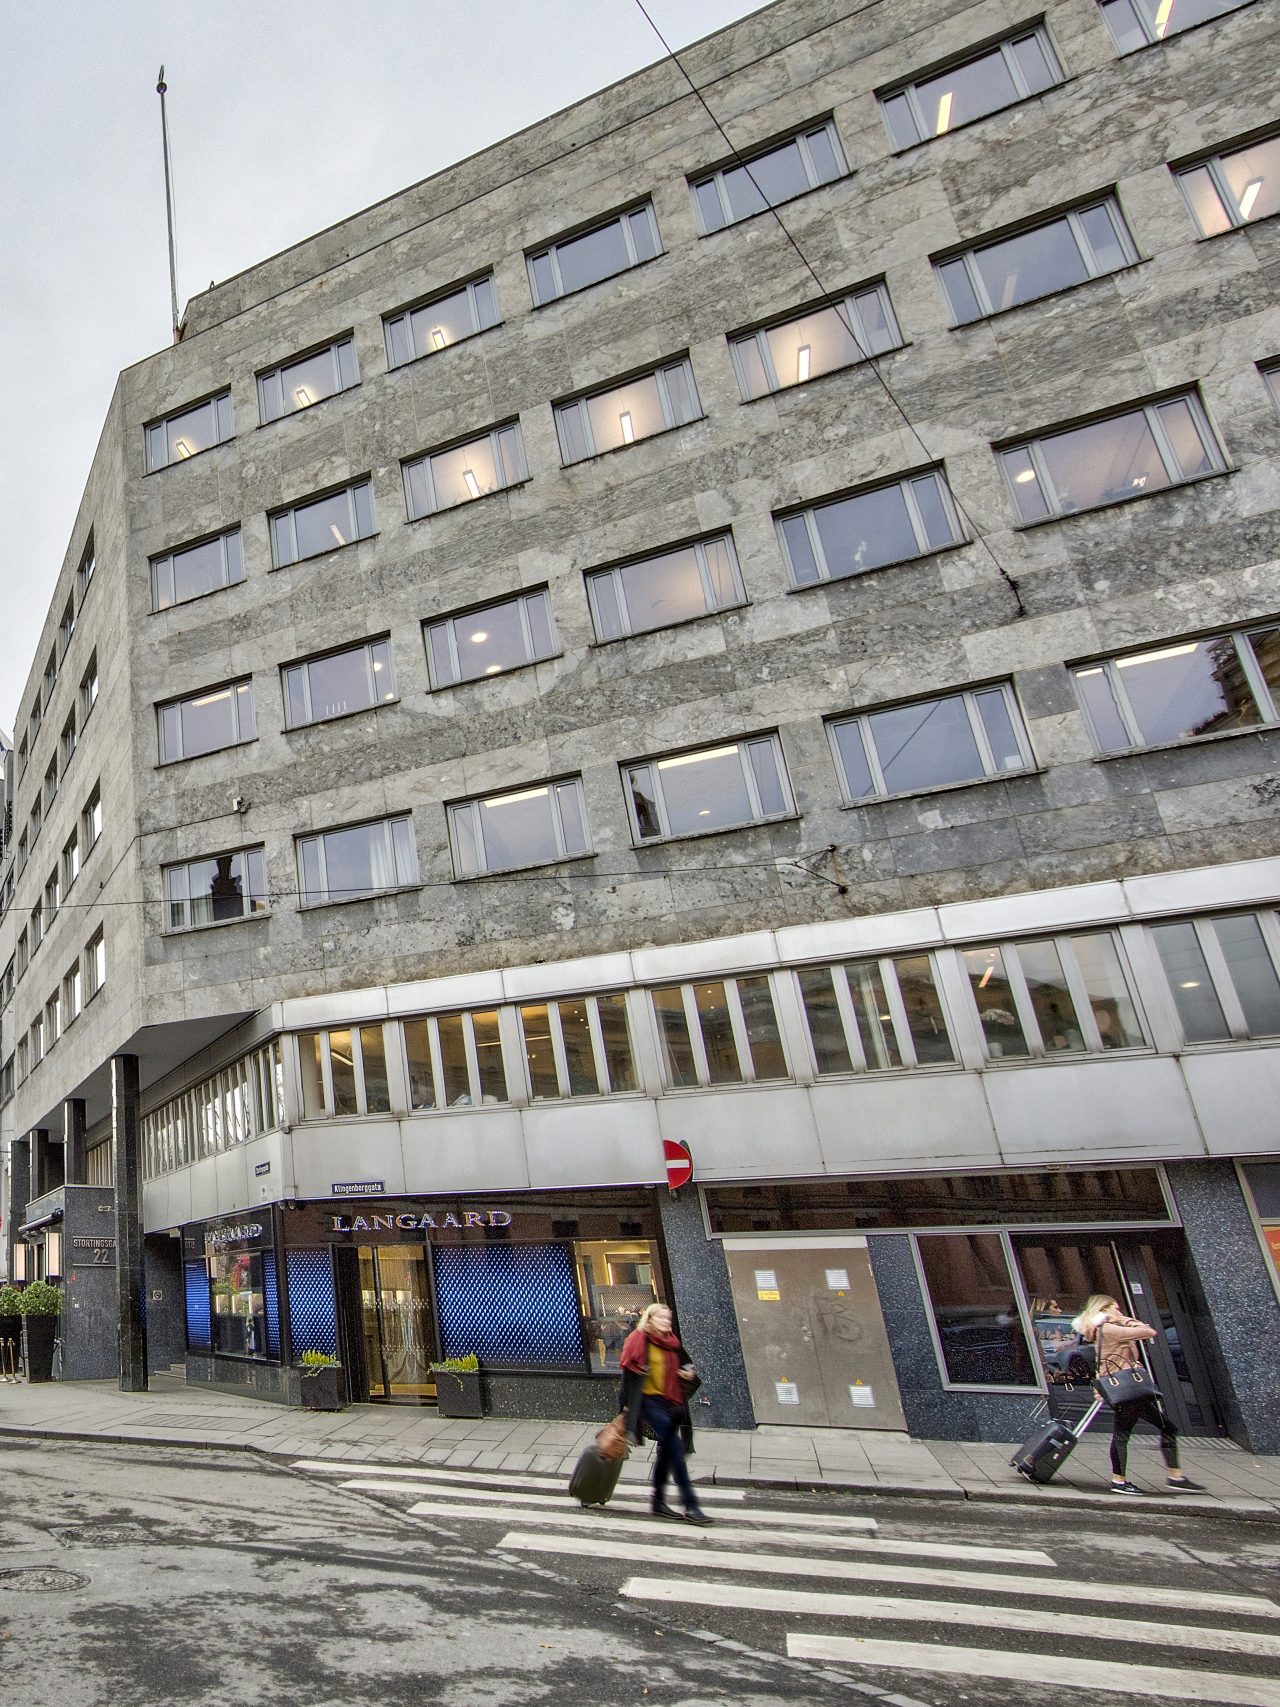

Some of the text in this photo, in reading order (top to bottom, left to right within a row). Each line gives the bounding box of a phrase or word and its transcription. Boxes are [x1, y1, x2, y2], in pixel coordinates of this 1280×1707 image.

[334, 1184, 381, 1193] Klingenberggata
[332, 1211, 512, 1232] LANGAARD
[93, 1248, 109, 1264] 22
